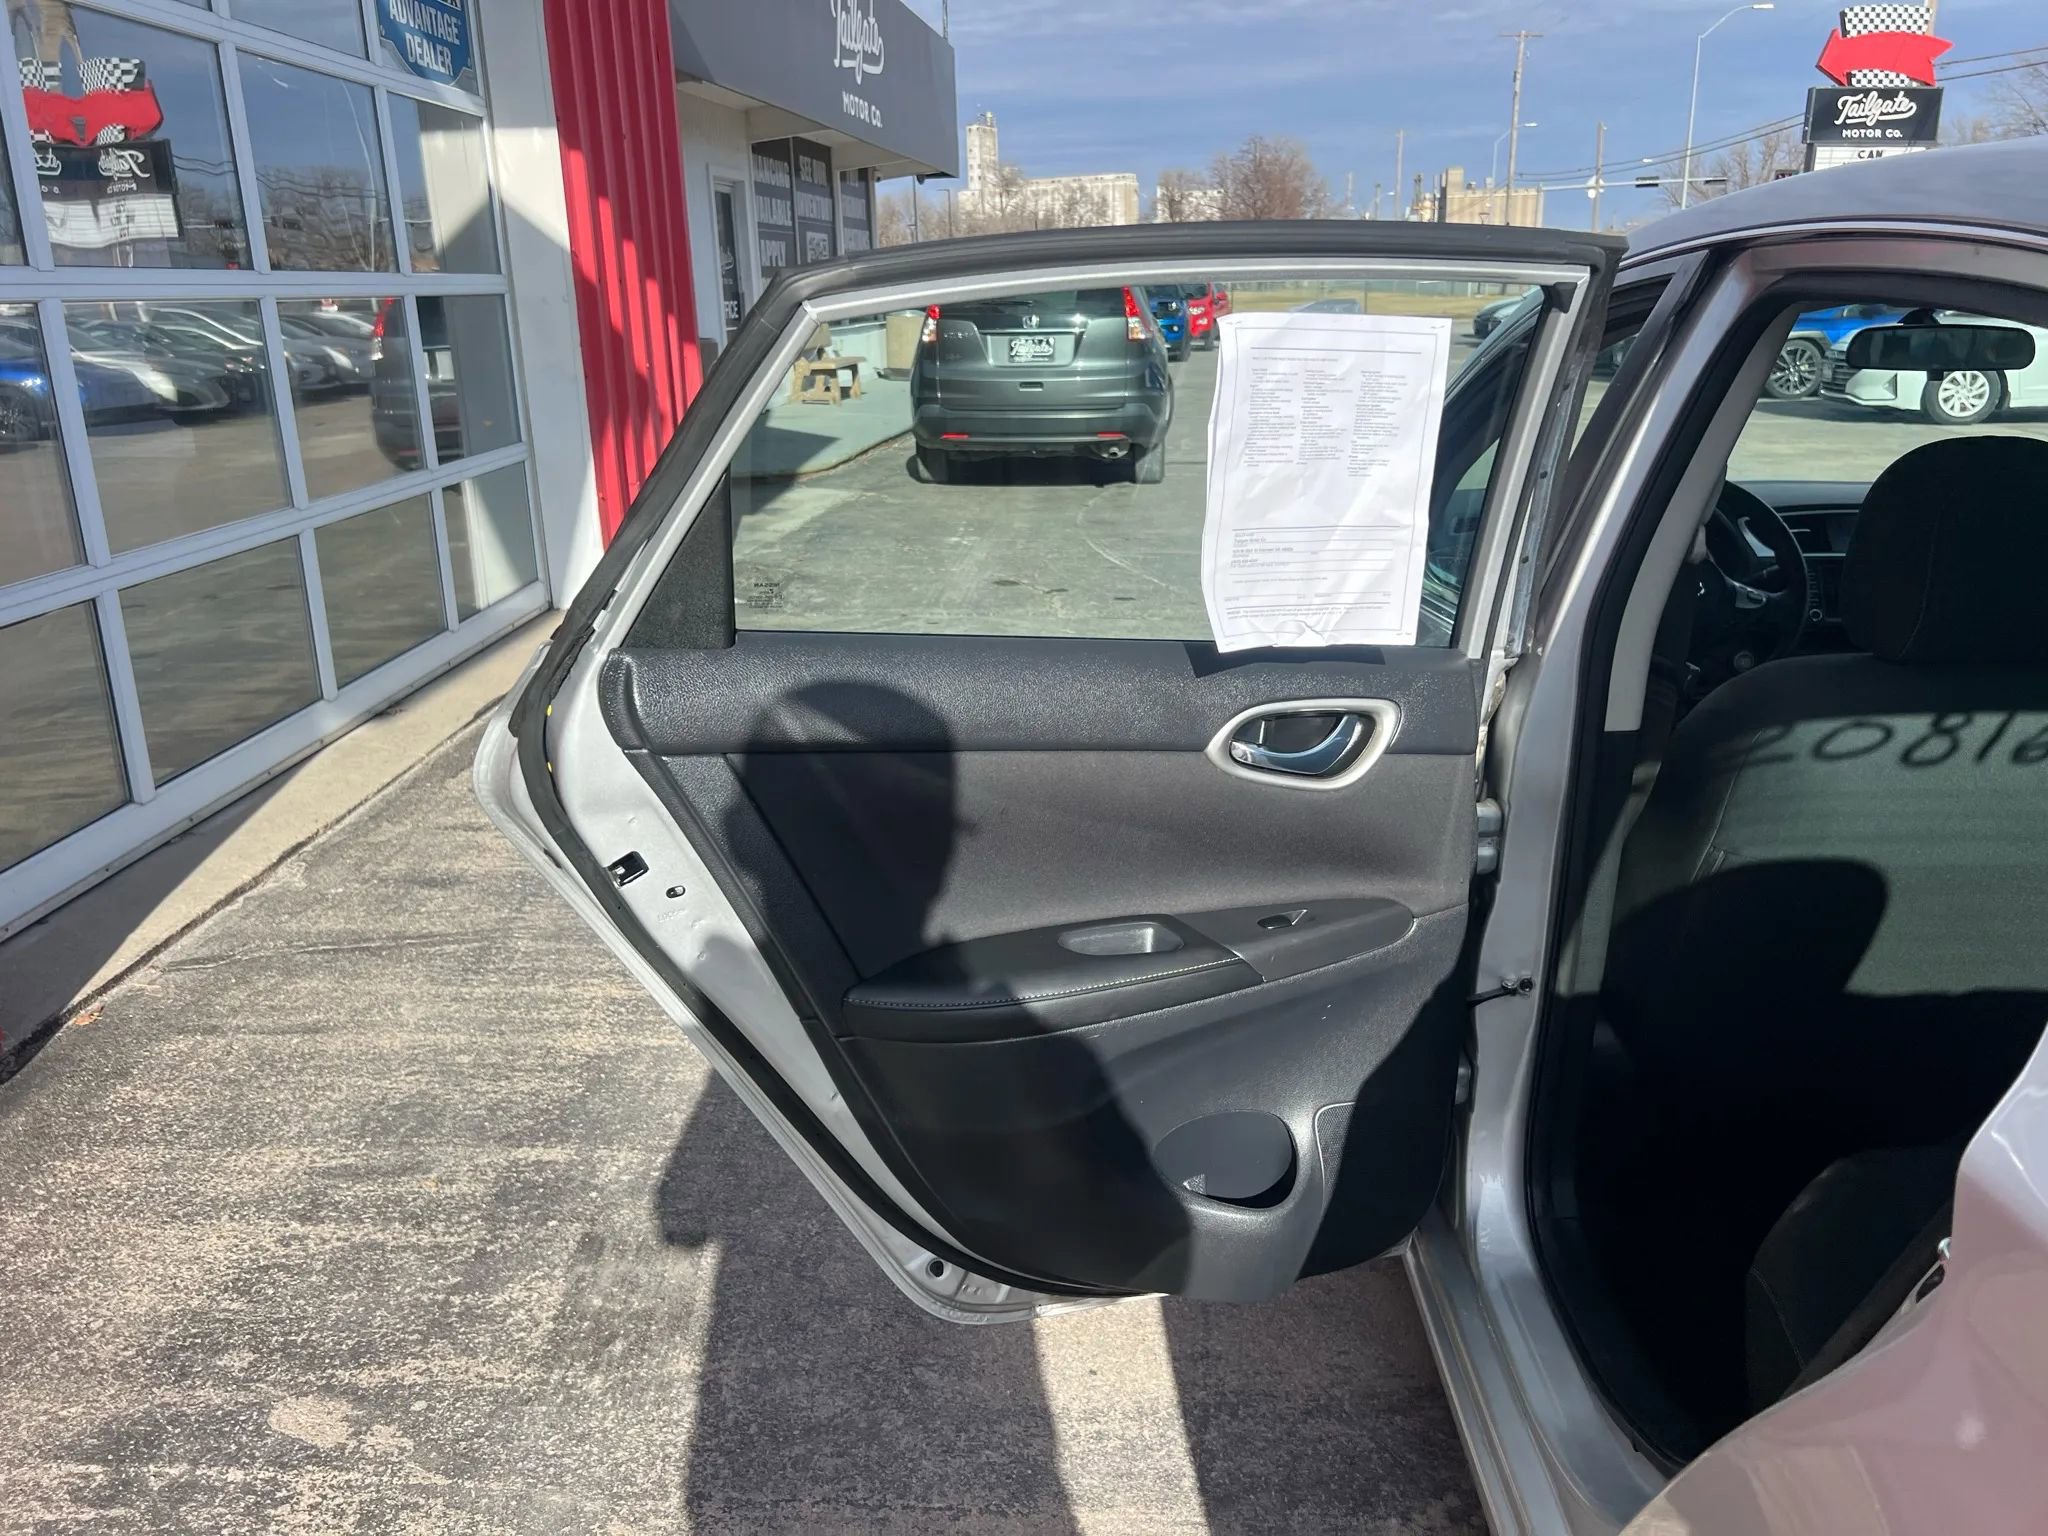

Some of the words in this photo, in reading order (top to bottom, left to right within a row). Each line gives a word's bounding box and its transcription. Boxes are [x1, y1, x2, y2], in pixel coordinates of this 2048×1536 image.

[389, 0, 461, 46] ADVANTAGE
[404, 31, 454, 77] DEALER
[842, 90, 870, 123] MOTOR
[1834, 91, 1917, 127] Tailgate
[1842, 128, 1882, 138] MOTOR
[1857, 149, 1884, 159] CAN
